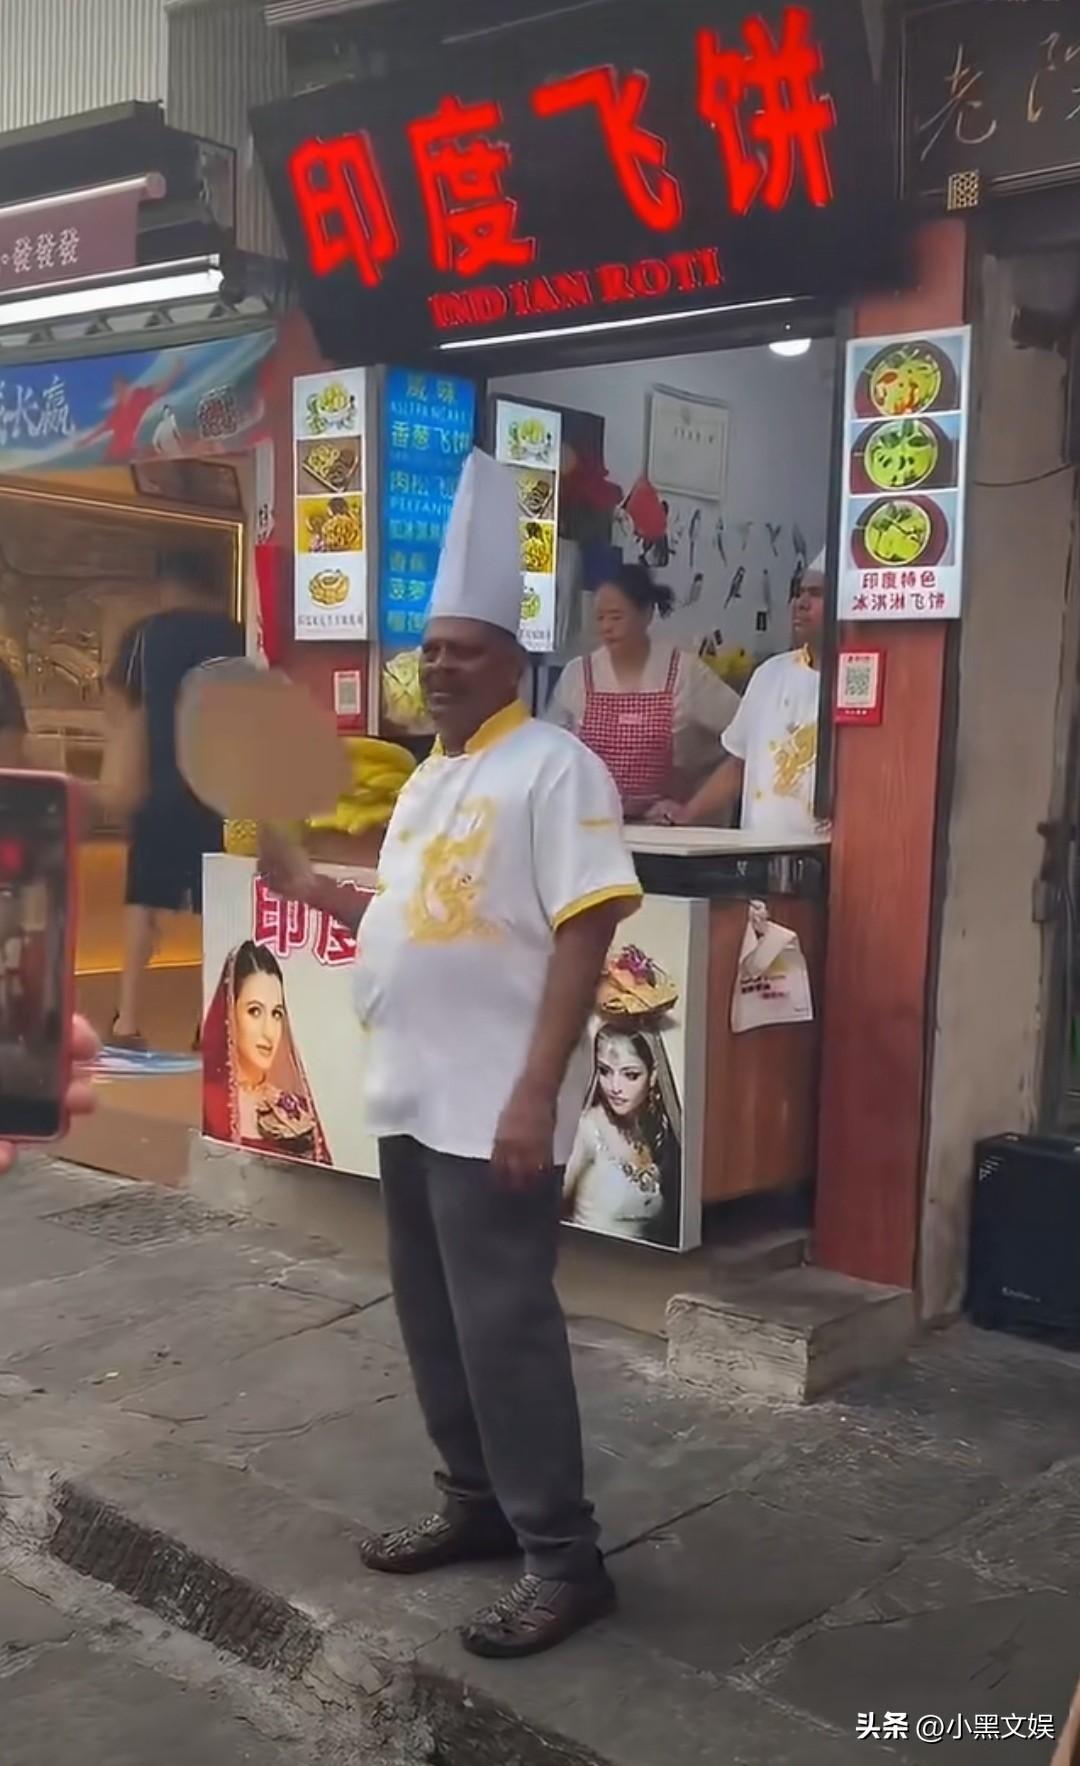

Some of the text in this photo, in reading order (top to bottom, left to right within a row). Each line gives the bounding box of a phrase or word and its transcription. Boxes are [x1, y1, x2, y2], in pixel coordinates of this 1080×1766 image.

[288, 5, 837, 288] 印度飞饼
[428, 246, 725, 330] INDIAN ROTI
[851, 591, 947, 612] 冰淇淋飞饼
[861, 570, 937, 590] 印度特色
